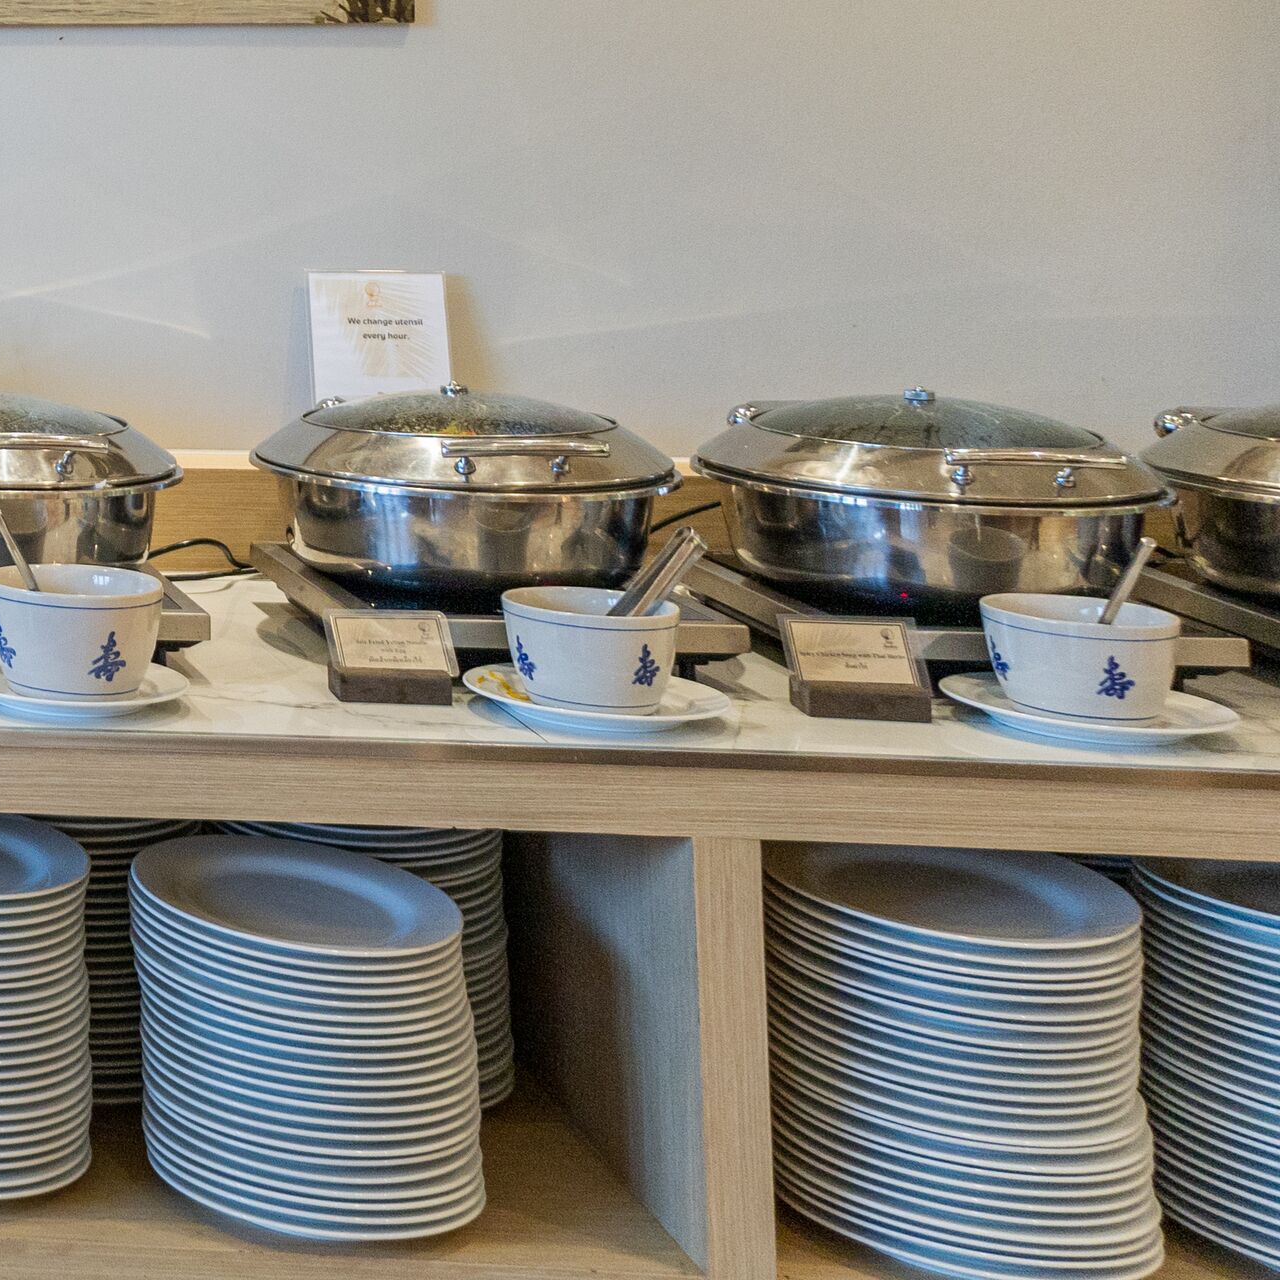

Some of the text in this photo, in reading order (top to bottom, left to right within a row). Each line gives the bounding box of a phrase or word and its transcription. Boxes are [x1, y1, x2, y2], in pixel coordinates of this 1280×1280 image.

[347, 317, 423, 327] We change utensil
[362, 332, 410, 341] every hour.
